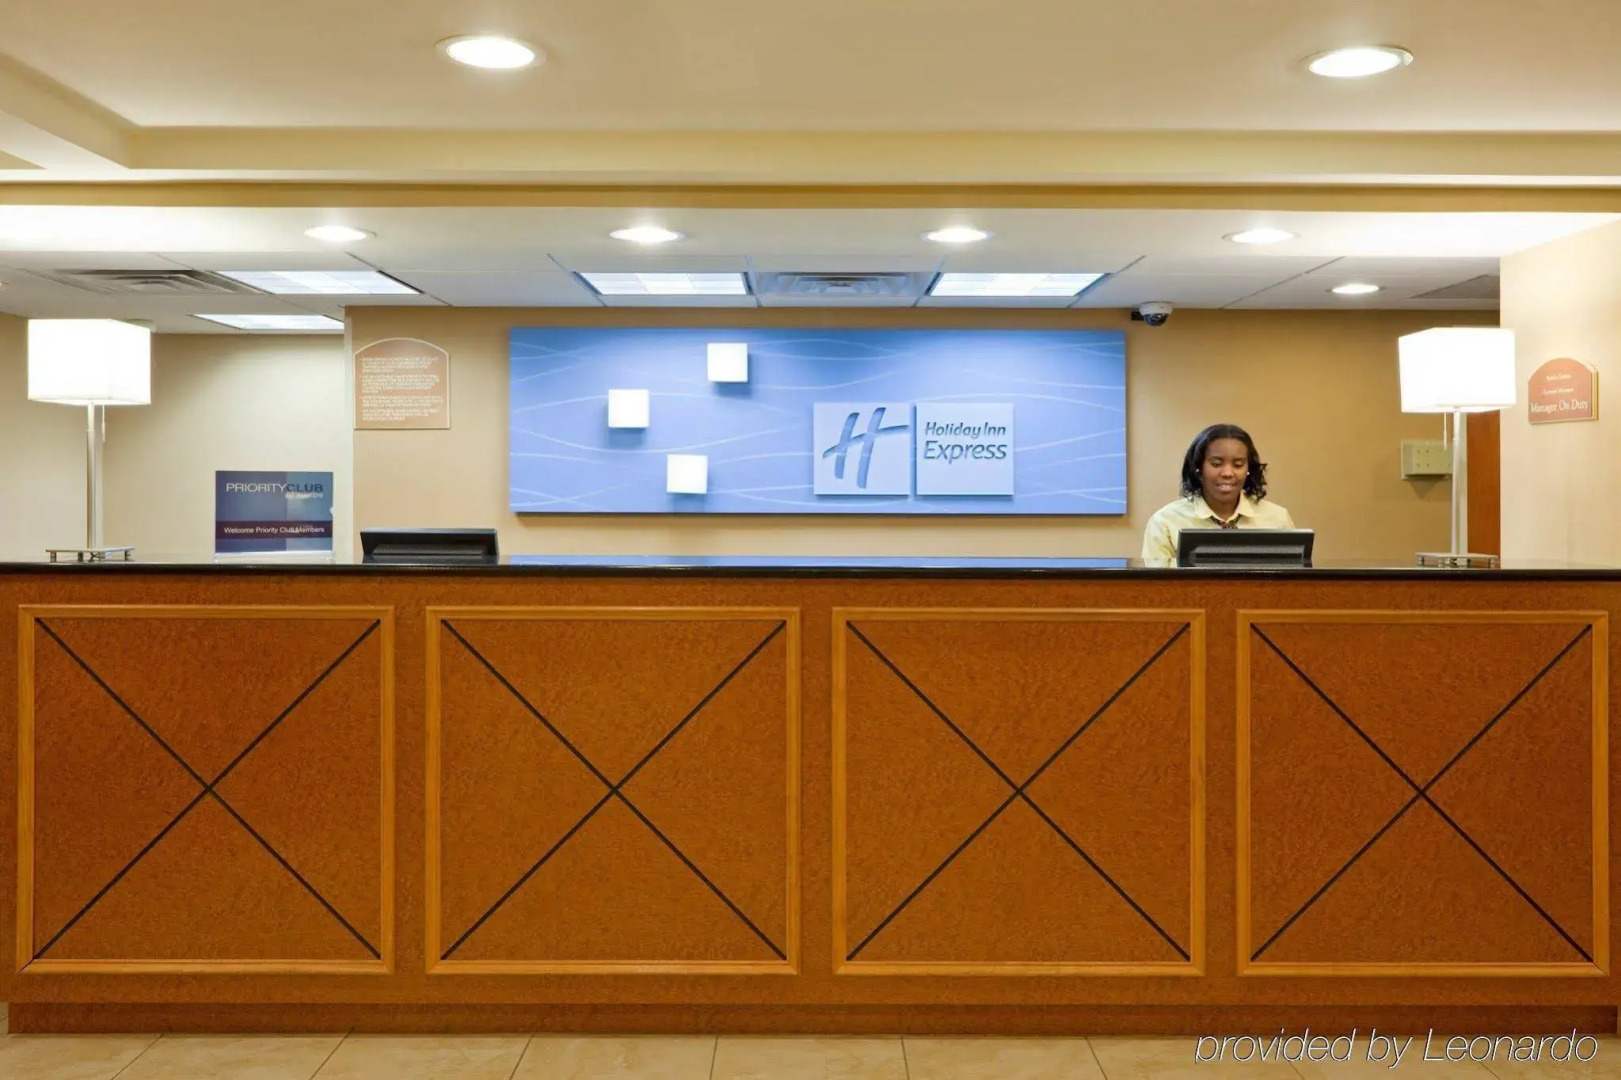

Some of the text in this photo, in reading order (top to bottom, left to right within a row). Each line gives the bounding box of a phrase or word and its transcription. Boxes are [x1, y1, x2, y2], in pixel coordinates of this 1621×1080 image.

[1530, 399, 1588, 415] Manager On Duty
[924, 422, 1006, 439] Holiday Inn
[923, 440, 1007, 464] Express
[224, 526, 254, 534] Welcome
[256, 526, 278, 535] Priority
